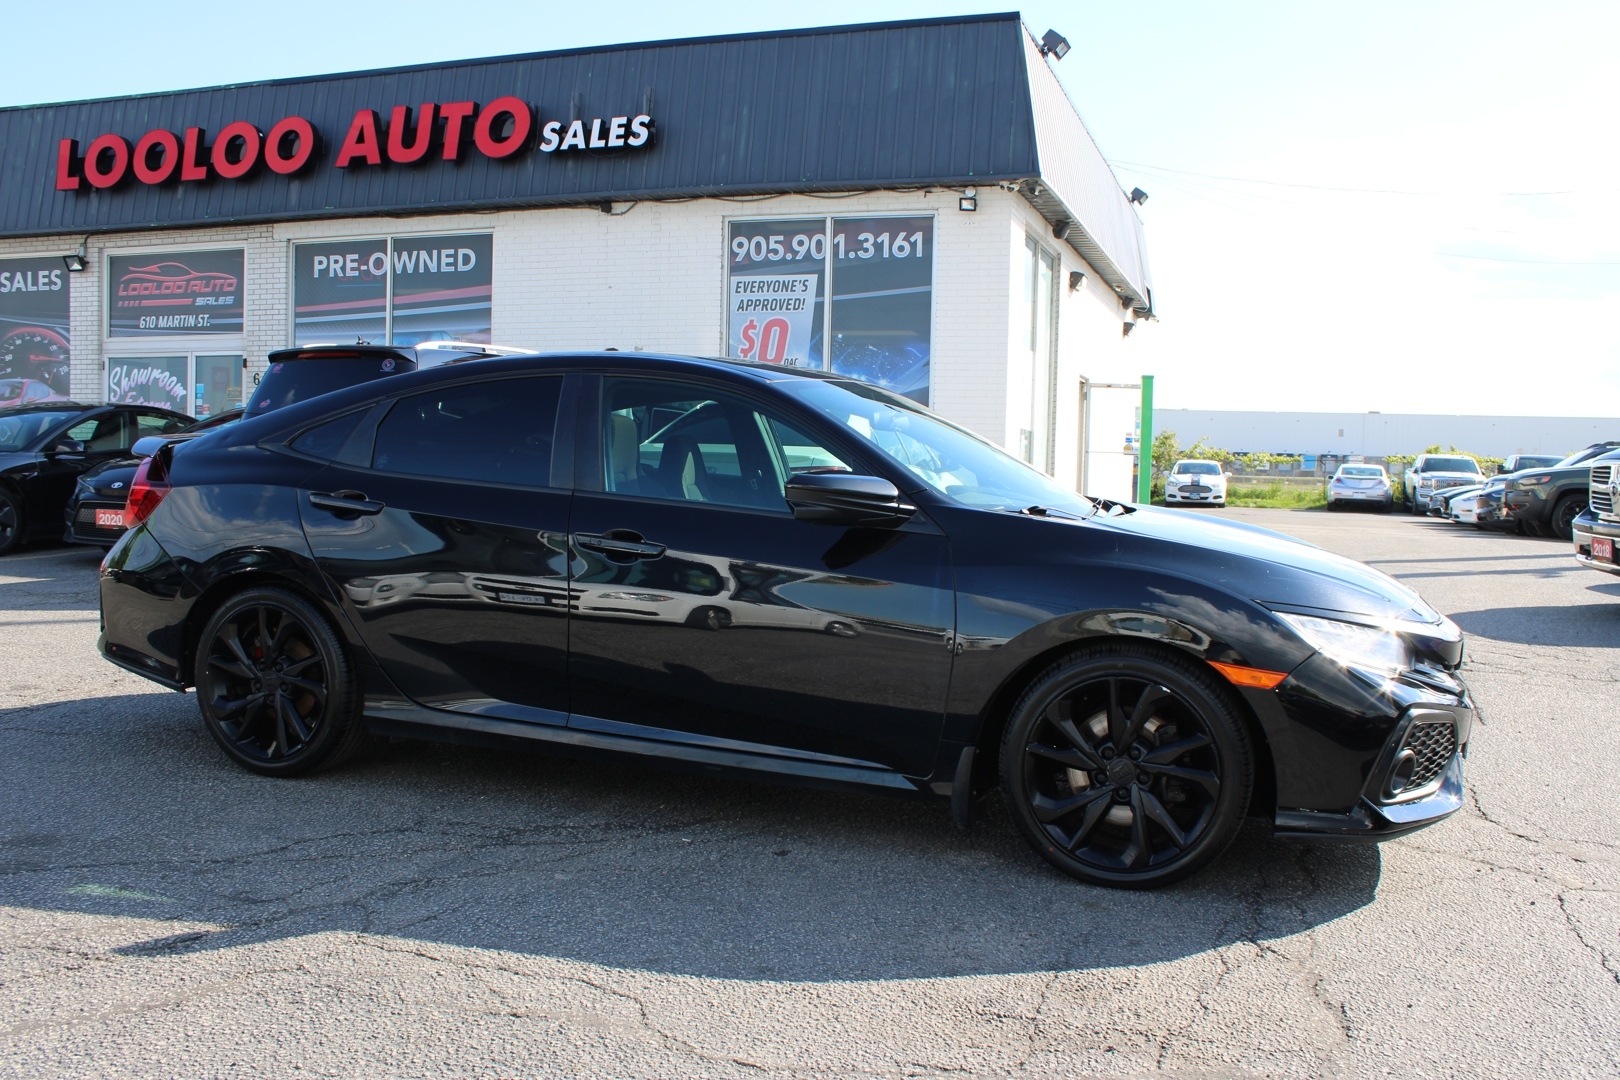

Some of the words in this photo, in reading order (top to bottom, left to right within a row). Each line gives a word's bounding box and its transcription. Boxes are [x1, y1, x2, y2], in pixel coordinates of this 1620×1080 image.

[56, 116, 315, 191] LOOLOO
[335, 96, 531, 167] AUTO
[539, 115, 652, 153] SALES
[732, 232, 923, 261] 905.901.3161
[313, 248, 476, 278] PRE-OWNED
[0, 270, 62, 293] SALES
[118, 281, 186, 296] LOOLOO
[187, 279, 237, 293] AUTO
[735, 279, 809, 294] EVERYONE'S
[195, 296, 235, 306] SALES
[737, 298, 805, 312] APPROVED!
[140, 316, 156, 329] 610
[158, 315, 196, 328] MARTIN
[198, 314, 211, 327] ST.
[740, 318, 789, 363] $0
[110, 365, 187, 401] Showroom
[99, 514, 122, 525] 2020
[1594, 544, 1609, 557] 2018
